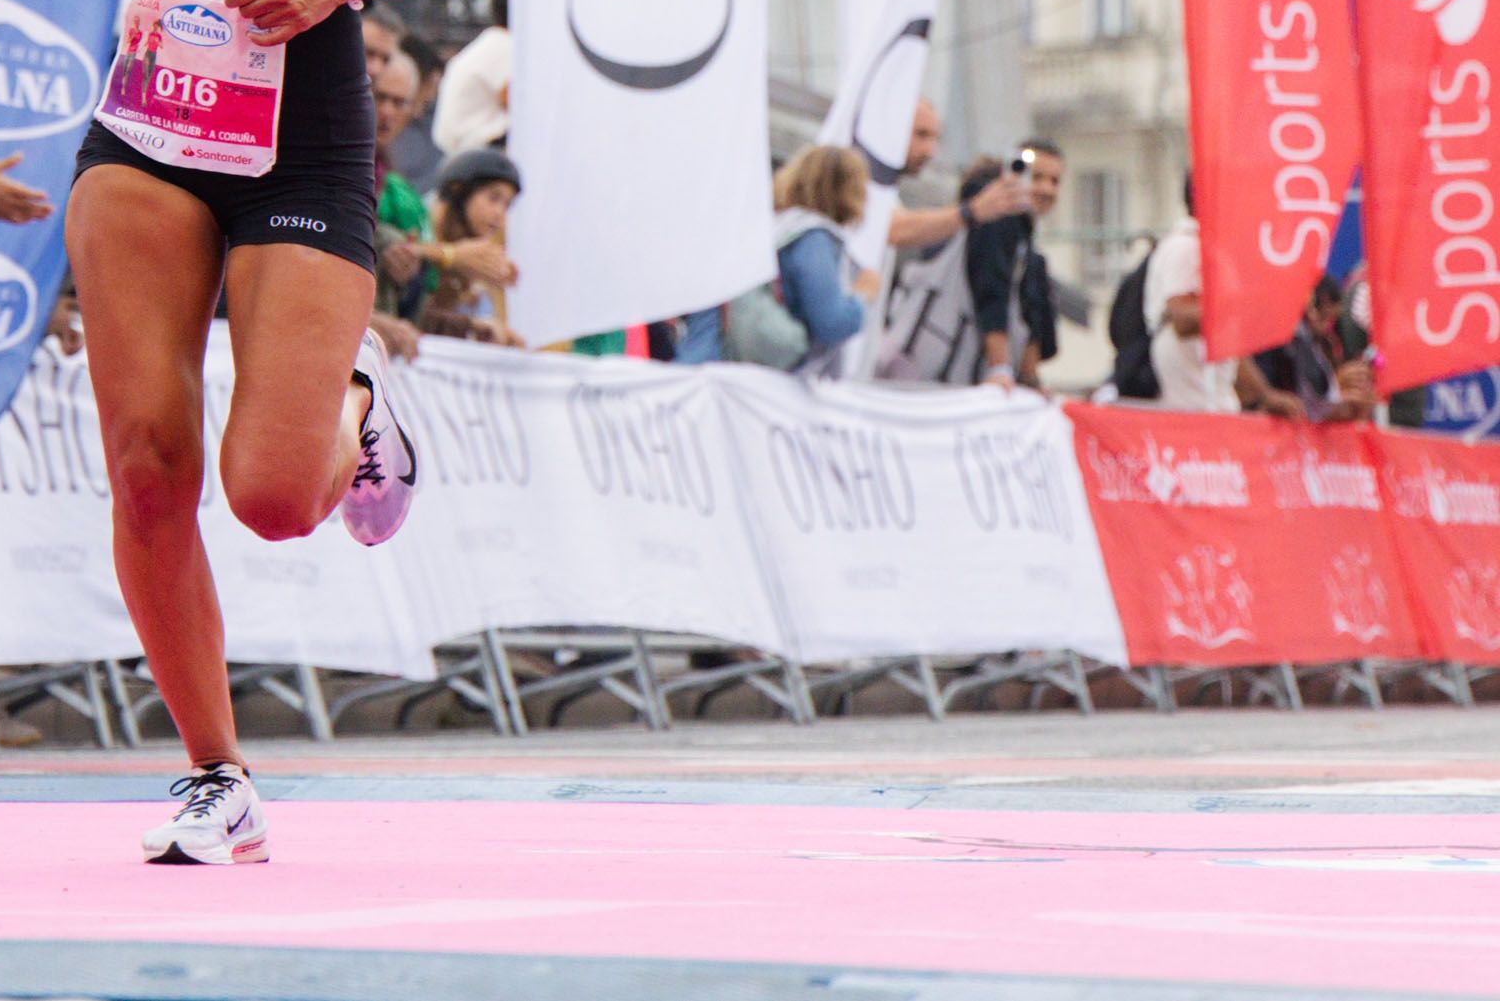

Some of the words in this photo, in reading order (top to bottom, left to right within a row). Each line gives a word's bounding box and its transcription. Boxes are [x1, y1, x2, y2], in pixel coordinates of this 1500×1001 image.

[167, 12, 226, 41] ASTURIANA
[155, 68, 219, 107] 016
[115, 106, 150, 122] CARRERA
[151, 116, 162, 126] DE
[162, 119, 172, 129] LA
[173, 121, 202, 137] MUJER
[209, 130, 216, 139] A
[218, 129, 257, 144] CORUÑA
[175, 107, 190, 120] 18
[196, 149, 252, 165] Santander
[1414, 58, 1500, 350] Sports
[269, 215, 327, 233] OYSHO
